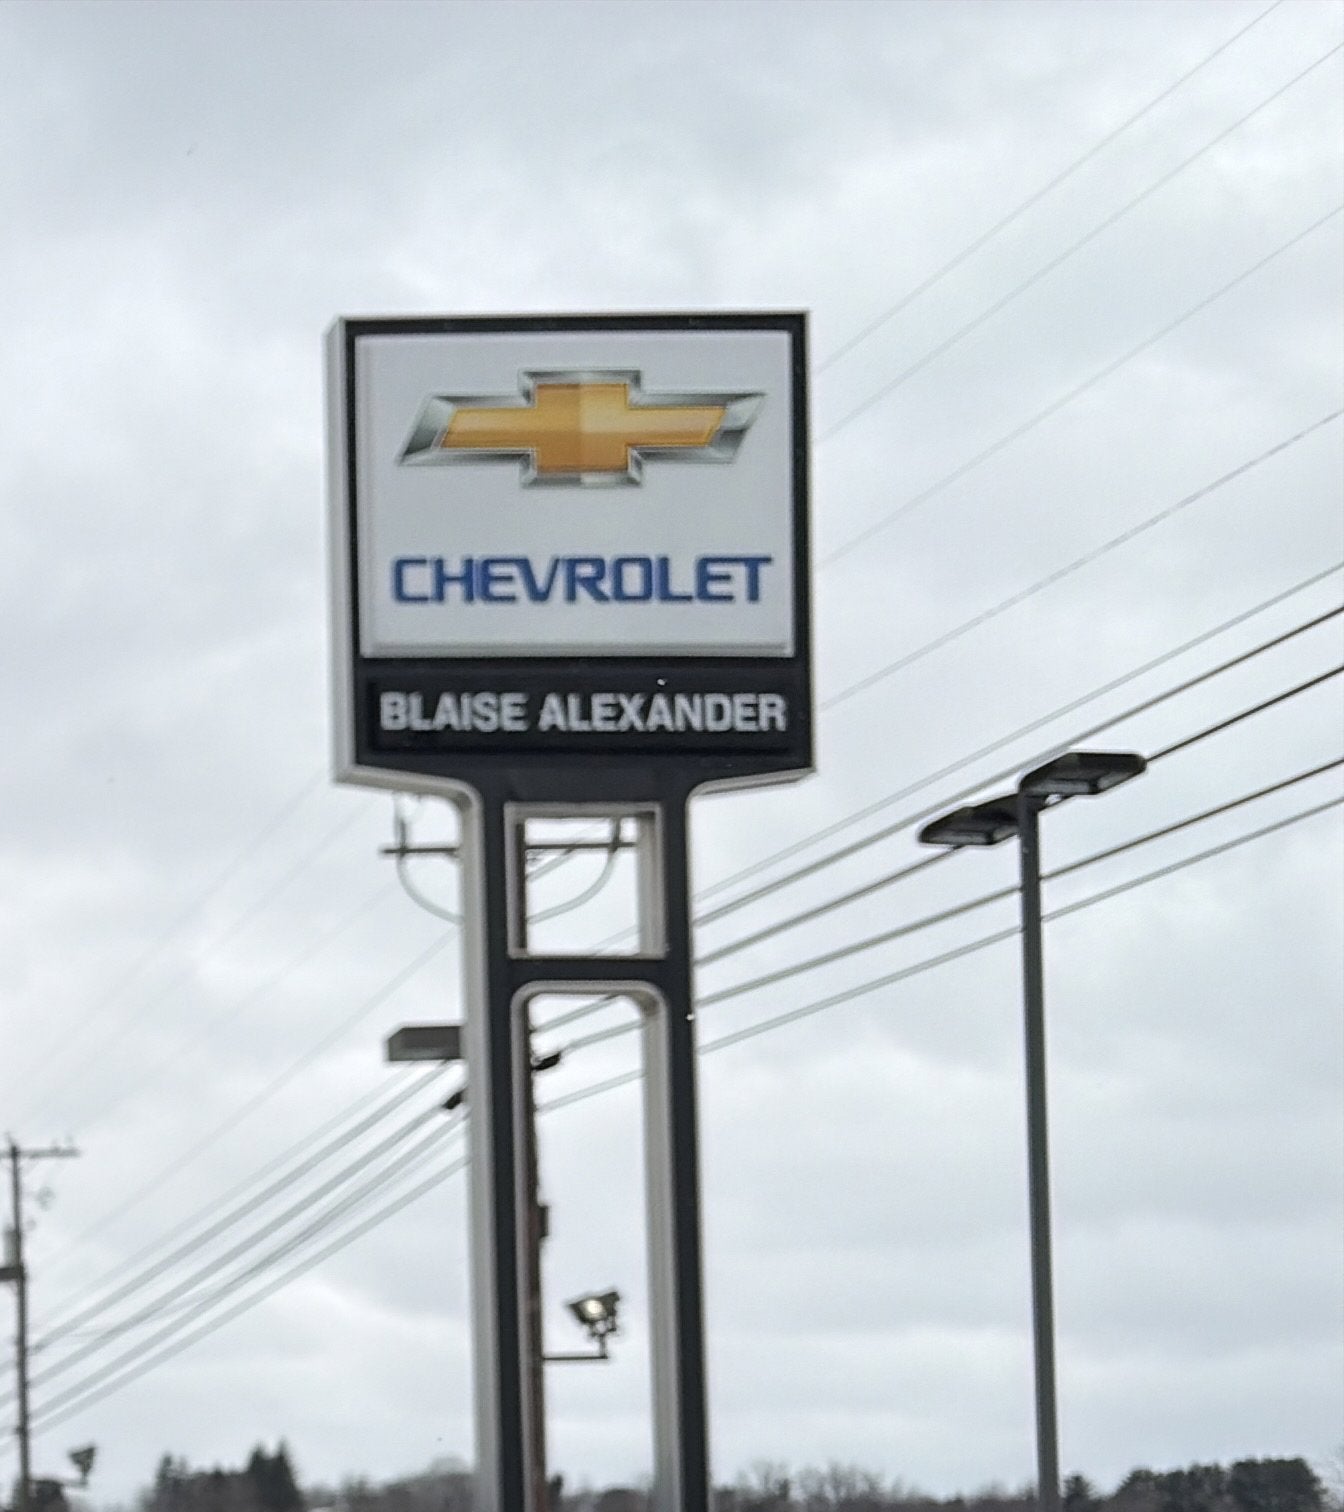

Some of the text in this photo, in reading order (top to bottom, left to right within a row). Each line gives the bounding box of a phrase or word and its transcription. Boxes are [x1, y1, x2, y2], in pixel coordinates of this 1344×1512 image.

[393, 556, 773, 604] CHEVROLET
[379, 691, 788, 732] BLAISE ALEXANDER
